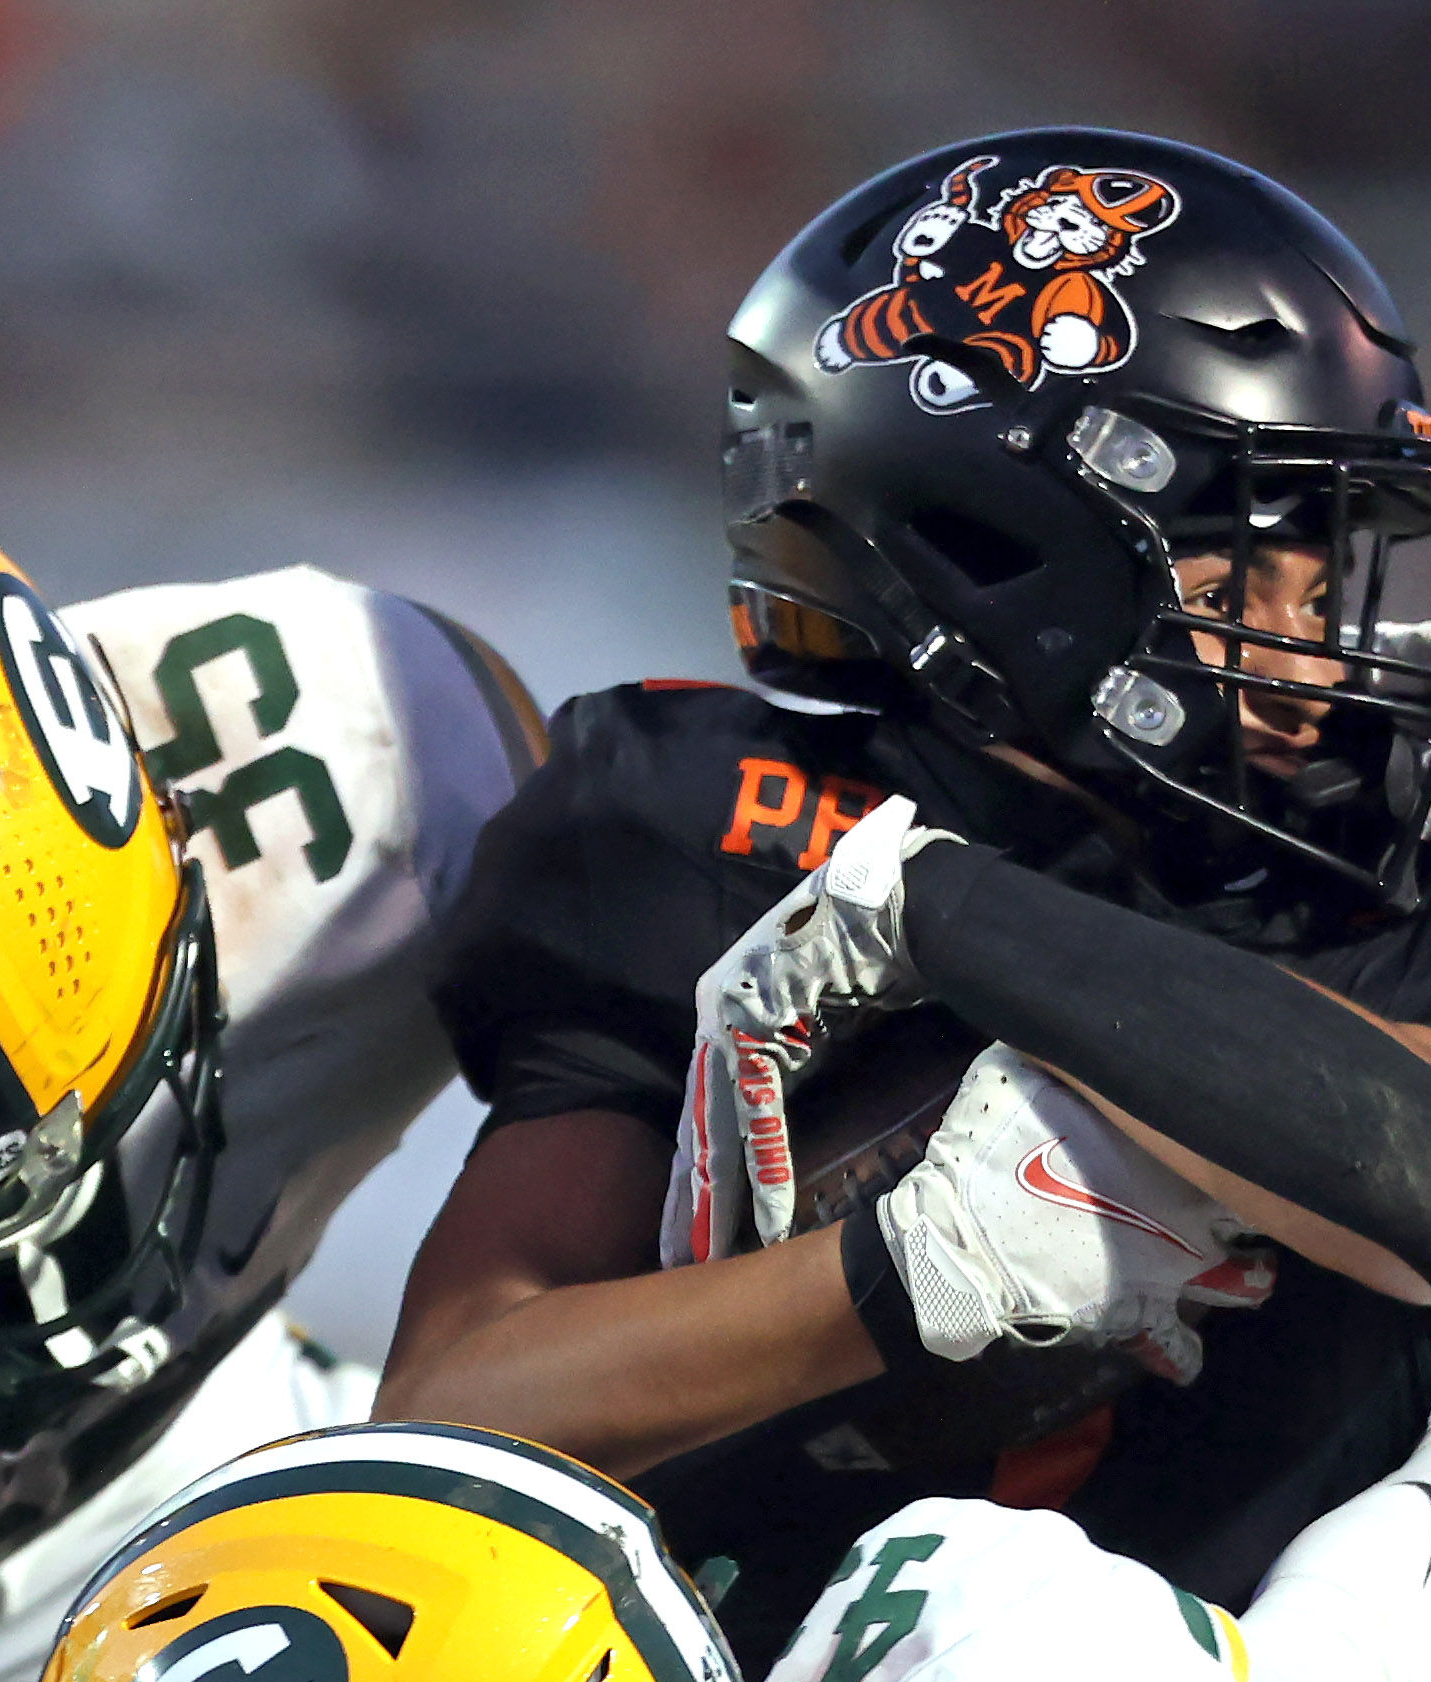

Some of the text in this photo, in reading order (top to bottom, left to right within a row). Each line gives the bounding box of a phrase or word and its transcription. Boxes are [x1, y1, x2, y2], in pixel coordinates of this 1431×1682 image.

[954, 261, 1027, 325] M
[142, 612, 355, 886] 35
[749, 1116, 790, 1185] OHIO
